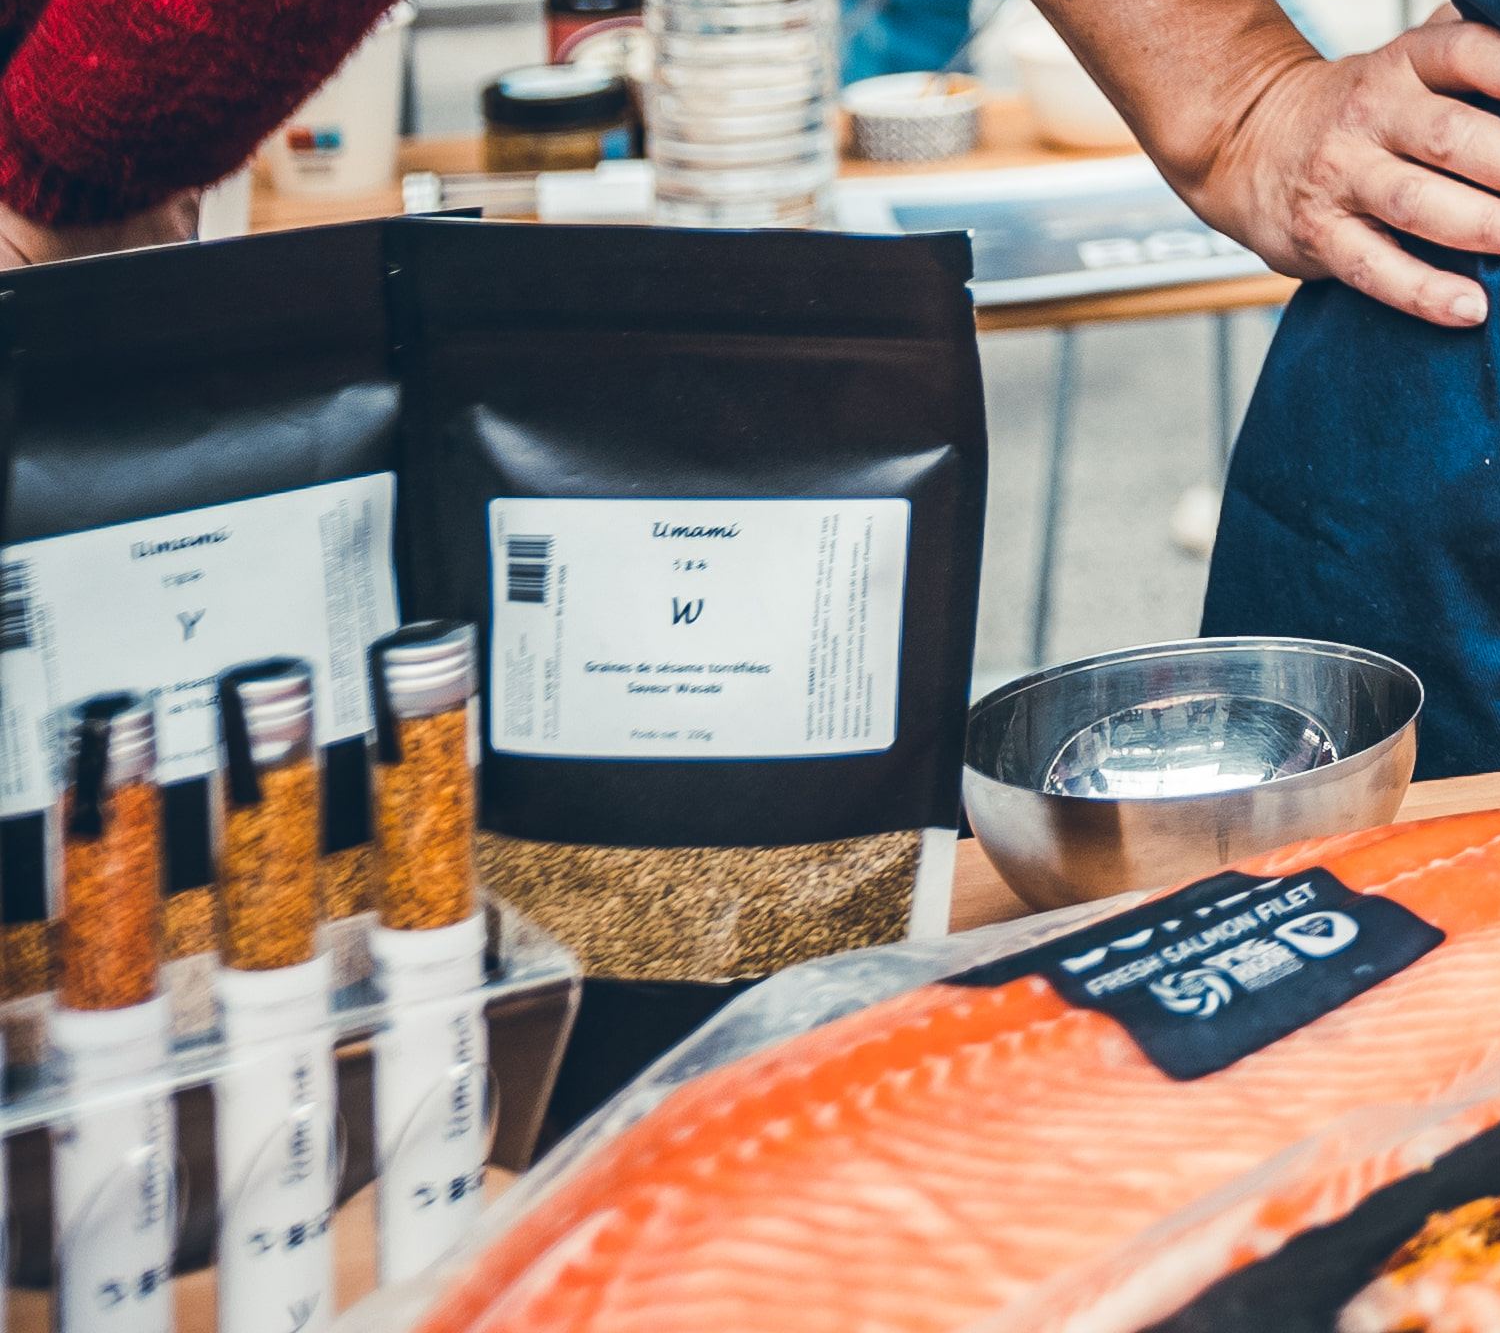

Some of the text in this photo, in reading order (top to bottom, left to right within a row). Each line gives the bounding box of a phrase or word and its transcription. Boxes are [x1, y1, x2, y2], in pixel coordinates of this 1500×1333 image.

[652, 520, 742, 539] Umami
[671, 596, 705, 626] W
[1161, 910, 1260, 964] SALMON
[1254, 881, 1319, 923] FILET
